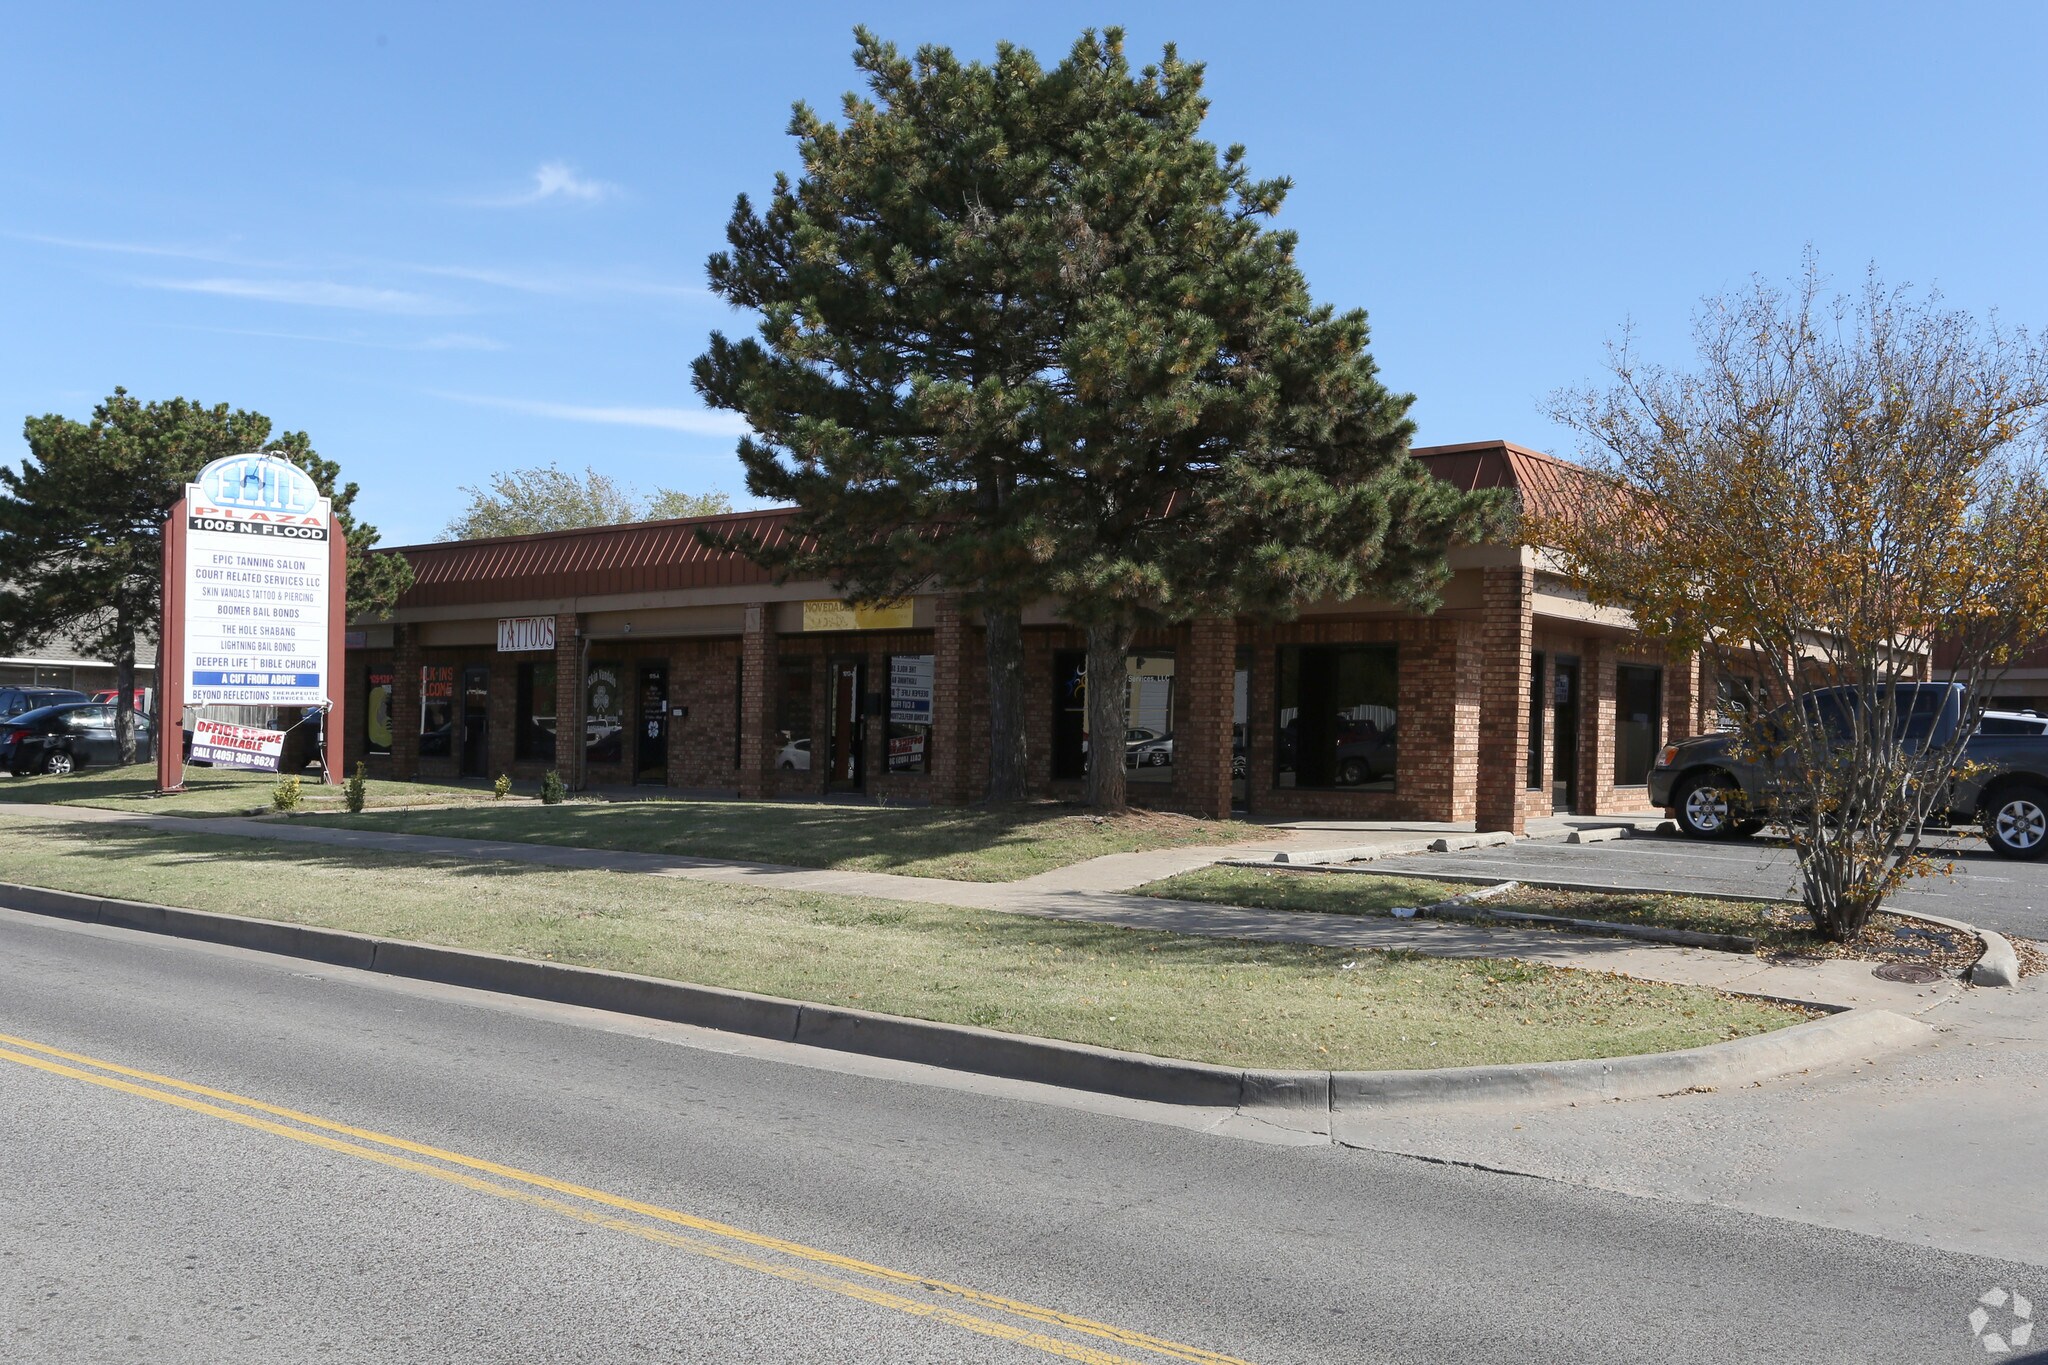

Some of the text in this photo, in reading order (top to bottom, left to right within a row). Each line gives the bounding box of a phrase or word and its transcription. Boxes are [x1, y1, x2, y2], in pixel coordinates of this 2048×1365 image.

[214, 458, 305, 511] ELITE
[195, 507, 321, 526] PLAZA
[194, 519, 324, 539] 1005 N. FLOOD
[212, 554, 305, 570] EPIC TANNING SALON
[196, 568, 320, 587] COURT RELATED SERVICES LLC
[202, 586, 314, 602] SKIN VANDALS TATTOO & PIERCING
[217, 605, 300, 618] BOOMER BAIL BONDS
[222, 624, 296, 637] THE HOLE SHABANG
[499, 617, 553, 649] TATTOOS
[220, 640, 296, 652] LIGHTNING BAIL BONDS
[196, 656, 317, 669] DEEPER LIFE BIBLE CHURCH
[221, 673, 296, 685] A CUT FROM ABOVE
[1157, 674, 1171, 682] LLC
[192, 689, 270, 701] BEYOND REFLECTIONS
[197, 721, 283, 744] OFFICE SPACE
[209, 736, 264, 752] AVAILABLE
[193, 746, 210, 758] CALL
[212, 750, 234, 761] (405)
